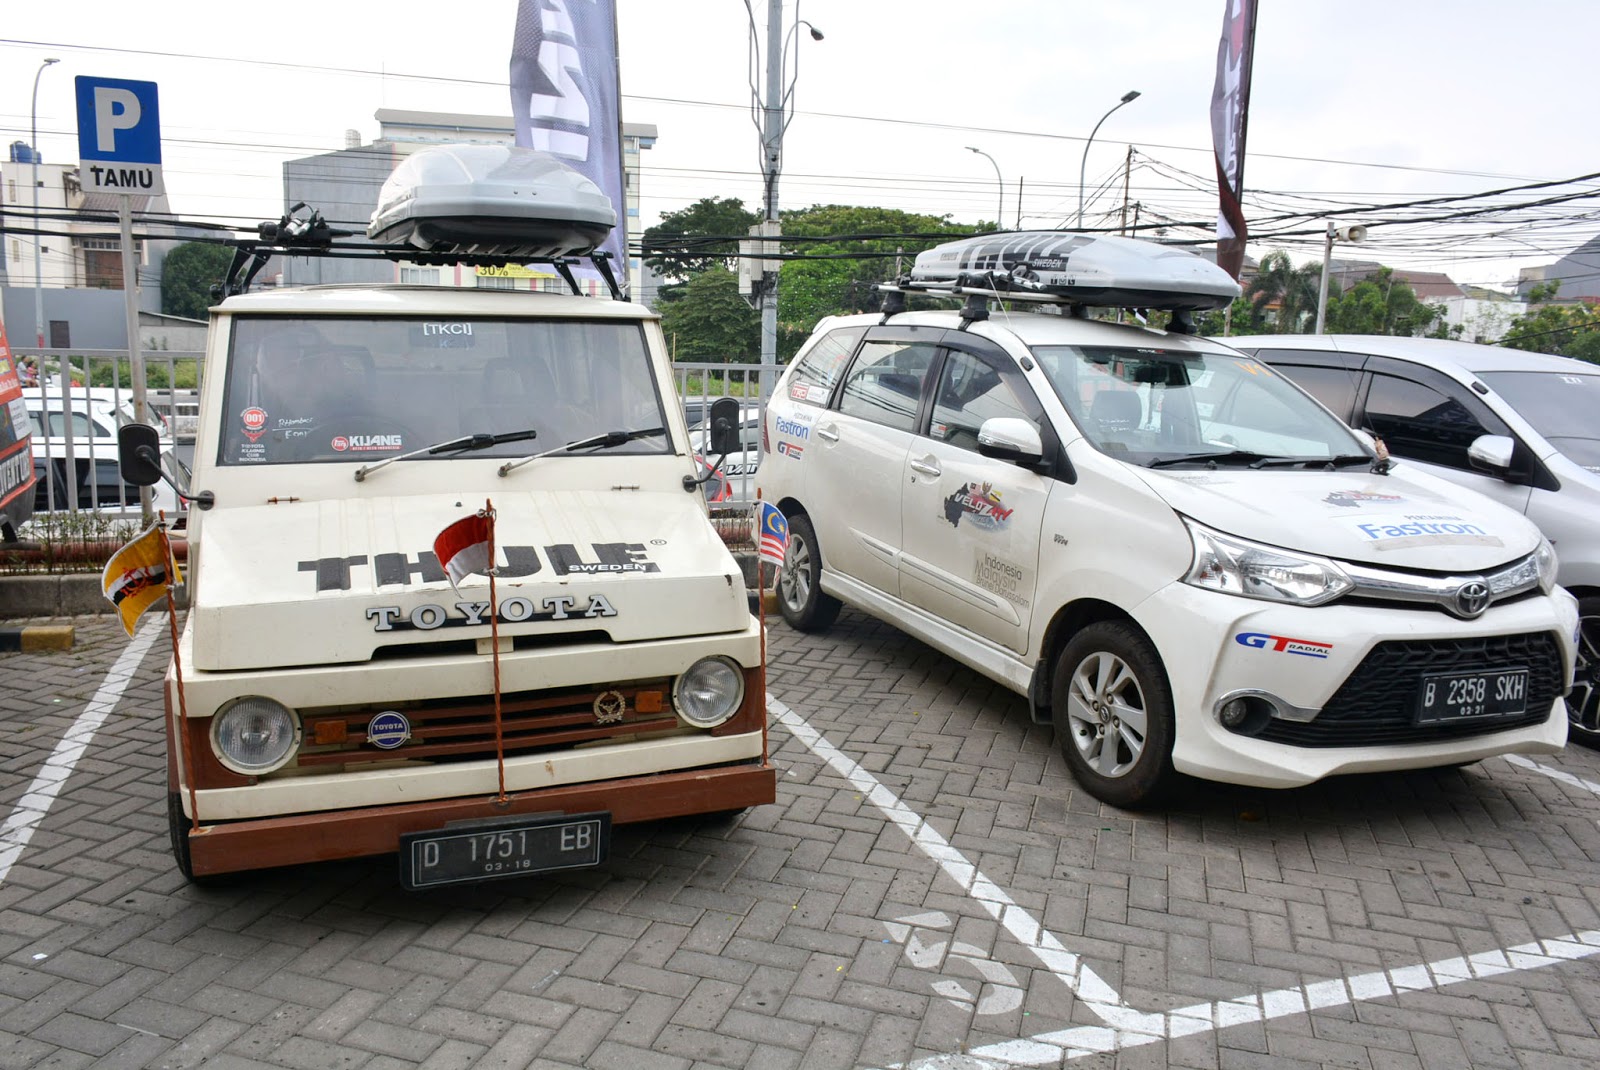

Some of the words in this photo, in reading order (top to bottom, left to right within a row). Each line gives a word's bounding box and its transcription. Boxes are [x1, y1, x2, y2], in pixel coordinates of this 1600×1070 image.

[94, 86, 141, 152] P
[90, 165, 153, 188] TAMU
[480, 265, 508, 276] 30%
[1032, 258, 1063, 268] SWEDEN
[246, 413, 262, 423] 001
[776, 416, 809, 440] Fastron
[777, 440, 803, 456] GT
[1357, 521, 1486, 540] Fastron
[568, 562, 647, 573] SWEDEN
[975, 560, 1017, 592] Malaysia
[984, 553, 1022, 581] Indonesia
[366, 594, 618, 632] TOYOTA
[1235, 632, 1333, 652] GT
[1289, 643, 1330, 655] RADIAL
[1424, 683, 1436, 707] B
[1447, 678, 1486, 705] 2358
[1495, 674, 1525, 701] SKH
[374, 723, 403, 731] TOYOTA
[424, 841, 440, 868] D
[468, 830, 527, 862] 1751
[560, 823, 592, 852] EB
